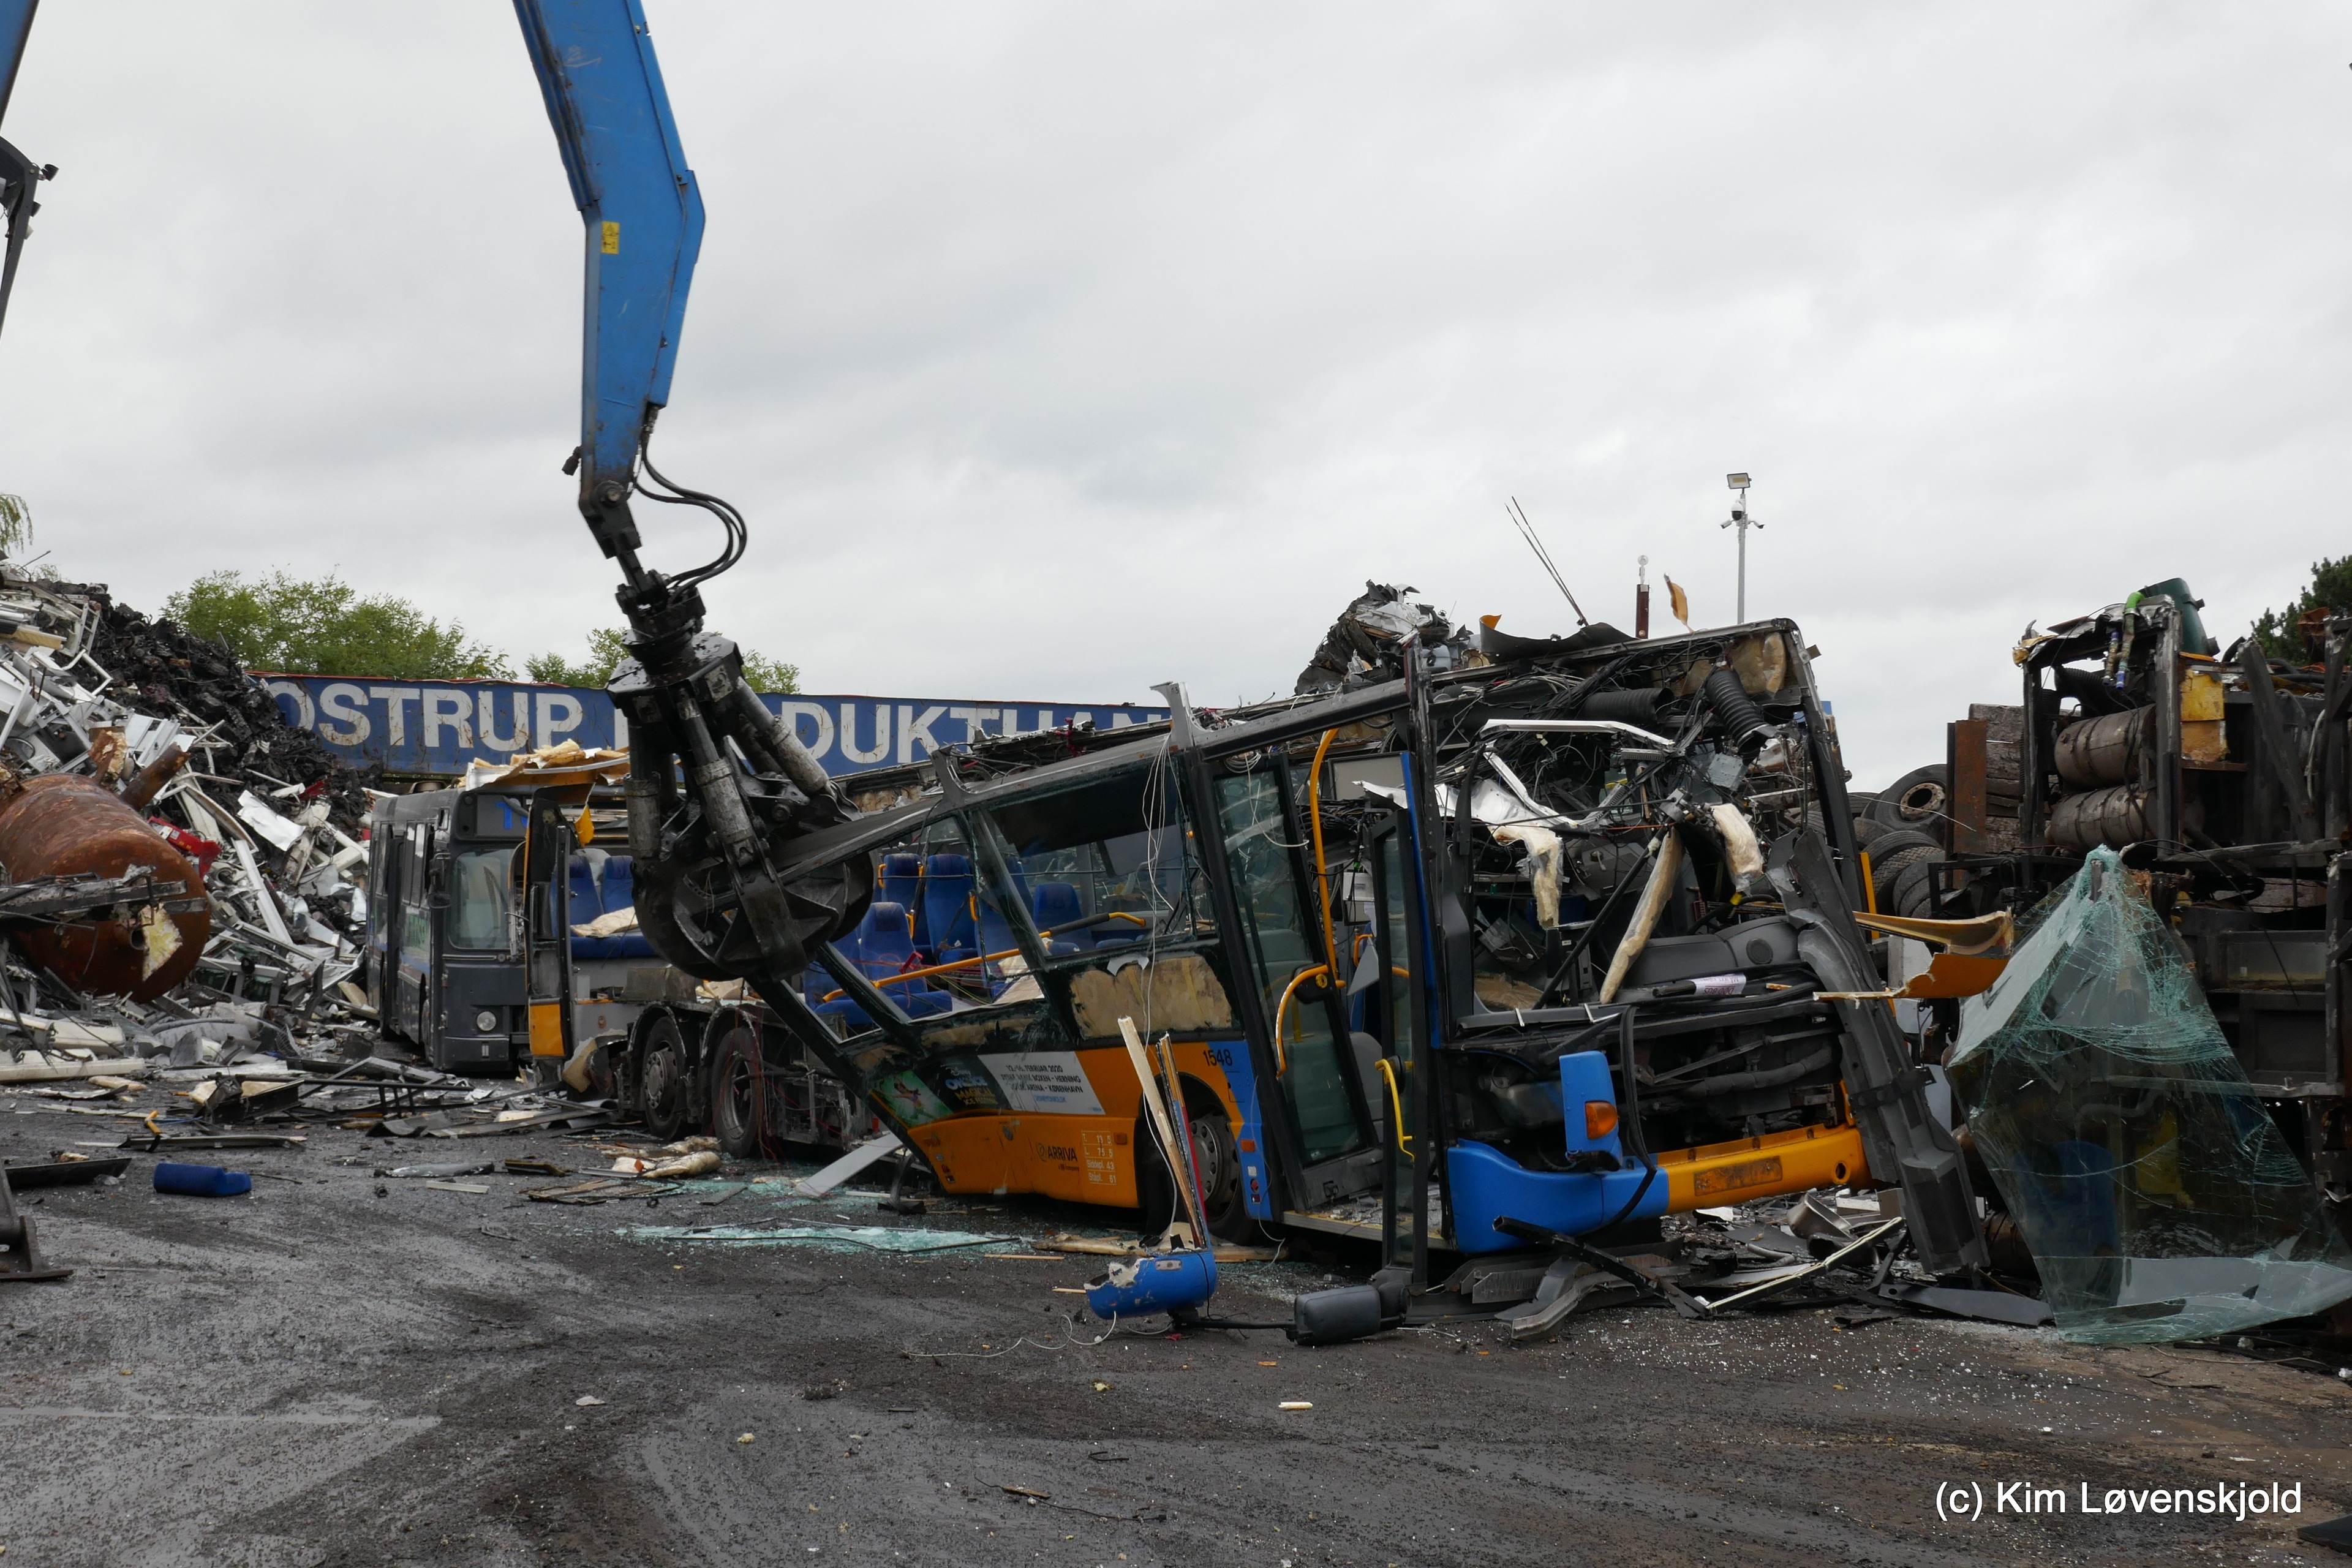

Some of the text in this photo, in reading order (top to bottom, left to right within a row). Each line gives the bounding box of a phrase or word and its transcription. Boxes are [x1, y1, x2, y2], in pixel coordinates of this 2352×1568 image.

[1203, 1049, 1233, 1066] 1548
[1031, 1074, 1051, 1083] BOXEN
[1055, 1075, 1082, 1084] HERNING
[1048, 1085, 1084, 1093] KØBENHAVN
[1047, 1145, 1078, 1162] ARRIVA
[1106, 1161, 1114, 1170] 43
[1109, 1175, 1117, 1183] 61
